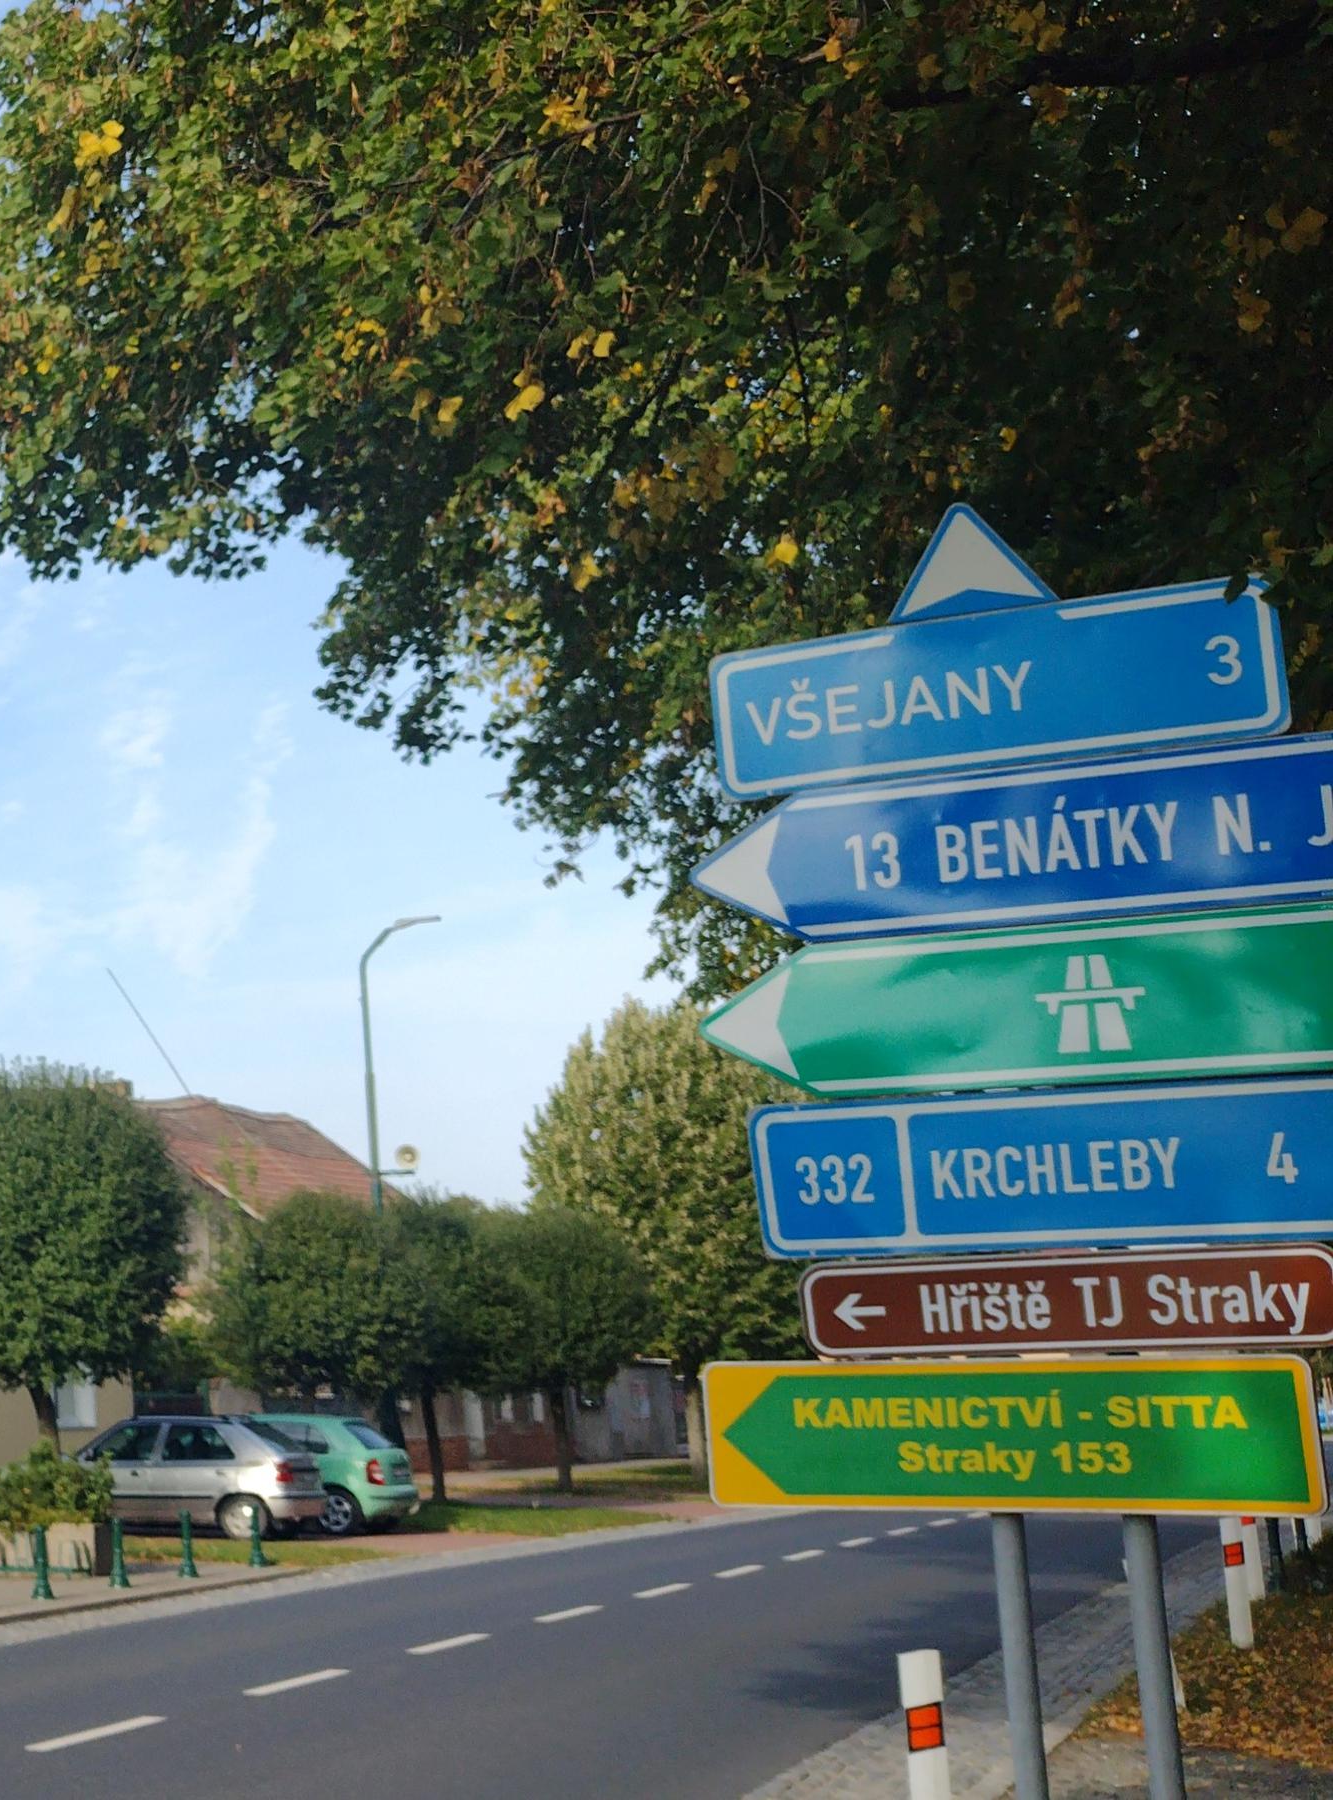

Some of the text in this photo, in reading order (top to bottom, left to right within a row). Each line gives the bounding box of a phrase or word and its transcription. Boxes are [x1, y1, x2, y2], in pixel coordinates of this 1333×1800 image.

[745, 634, 1243, 747] VŠEJANY 3
[844, 832, 901, 891] 13
[935, 795, 1178, 884] BENÁTKY
[1212, 793, 1272, 856] N.
[795, 1131, 1299, 1205] 332 KRCHLEBY 4
[919, 1271, 1310, 1335] Hřiště TJ Straky
[792, 1389, 1063, 1429] KAMENICTVÍ
[1107, 1395, 1249, 1429] SITTA
[897, 1440, 1133, 1482] Straky 153
